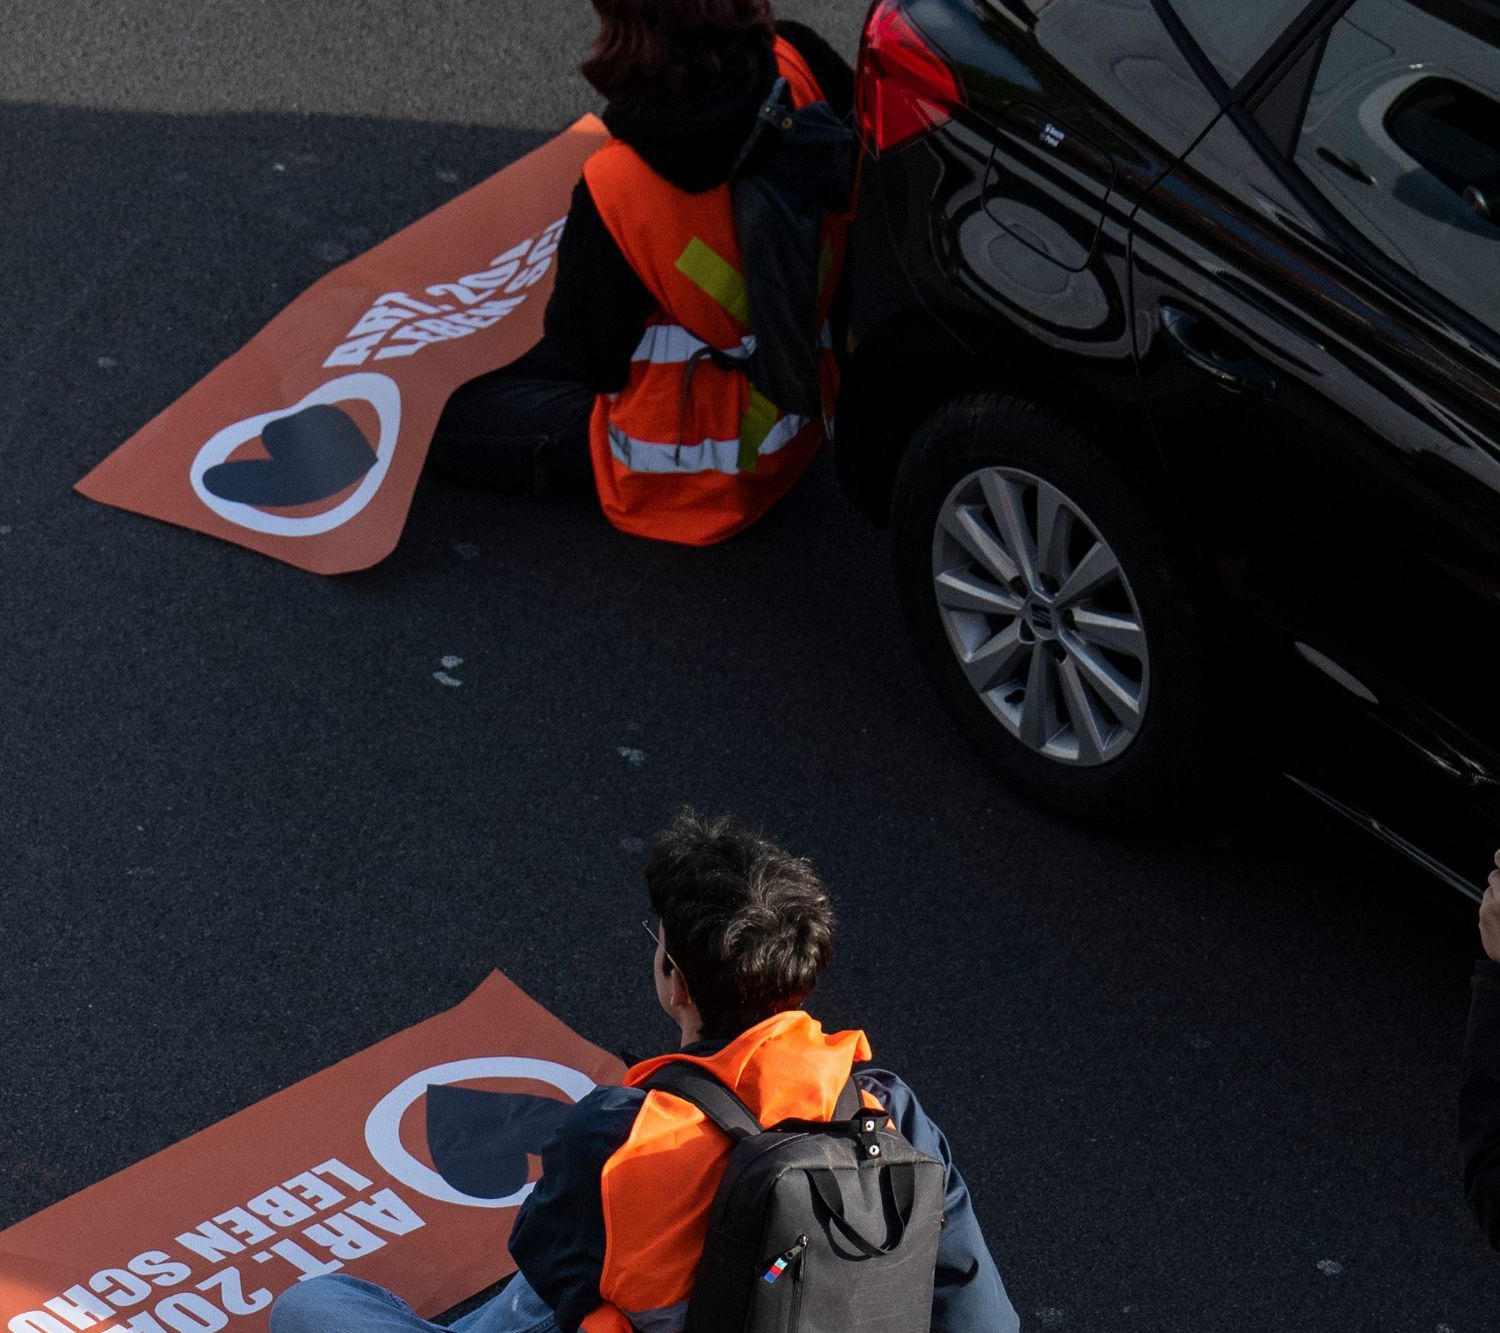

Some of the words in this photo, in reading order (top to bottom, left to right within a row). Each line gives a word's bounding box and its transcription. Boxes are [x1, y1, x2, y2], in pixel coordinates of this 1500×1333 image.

[322, 290, 456, 369] ART.
[174, 1157, 374, 1264] LEBEN
[252, 1187, 427, 1284] ART.
